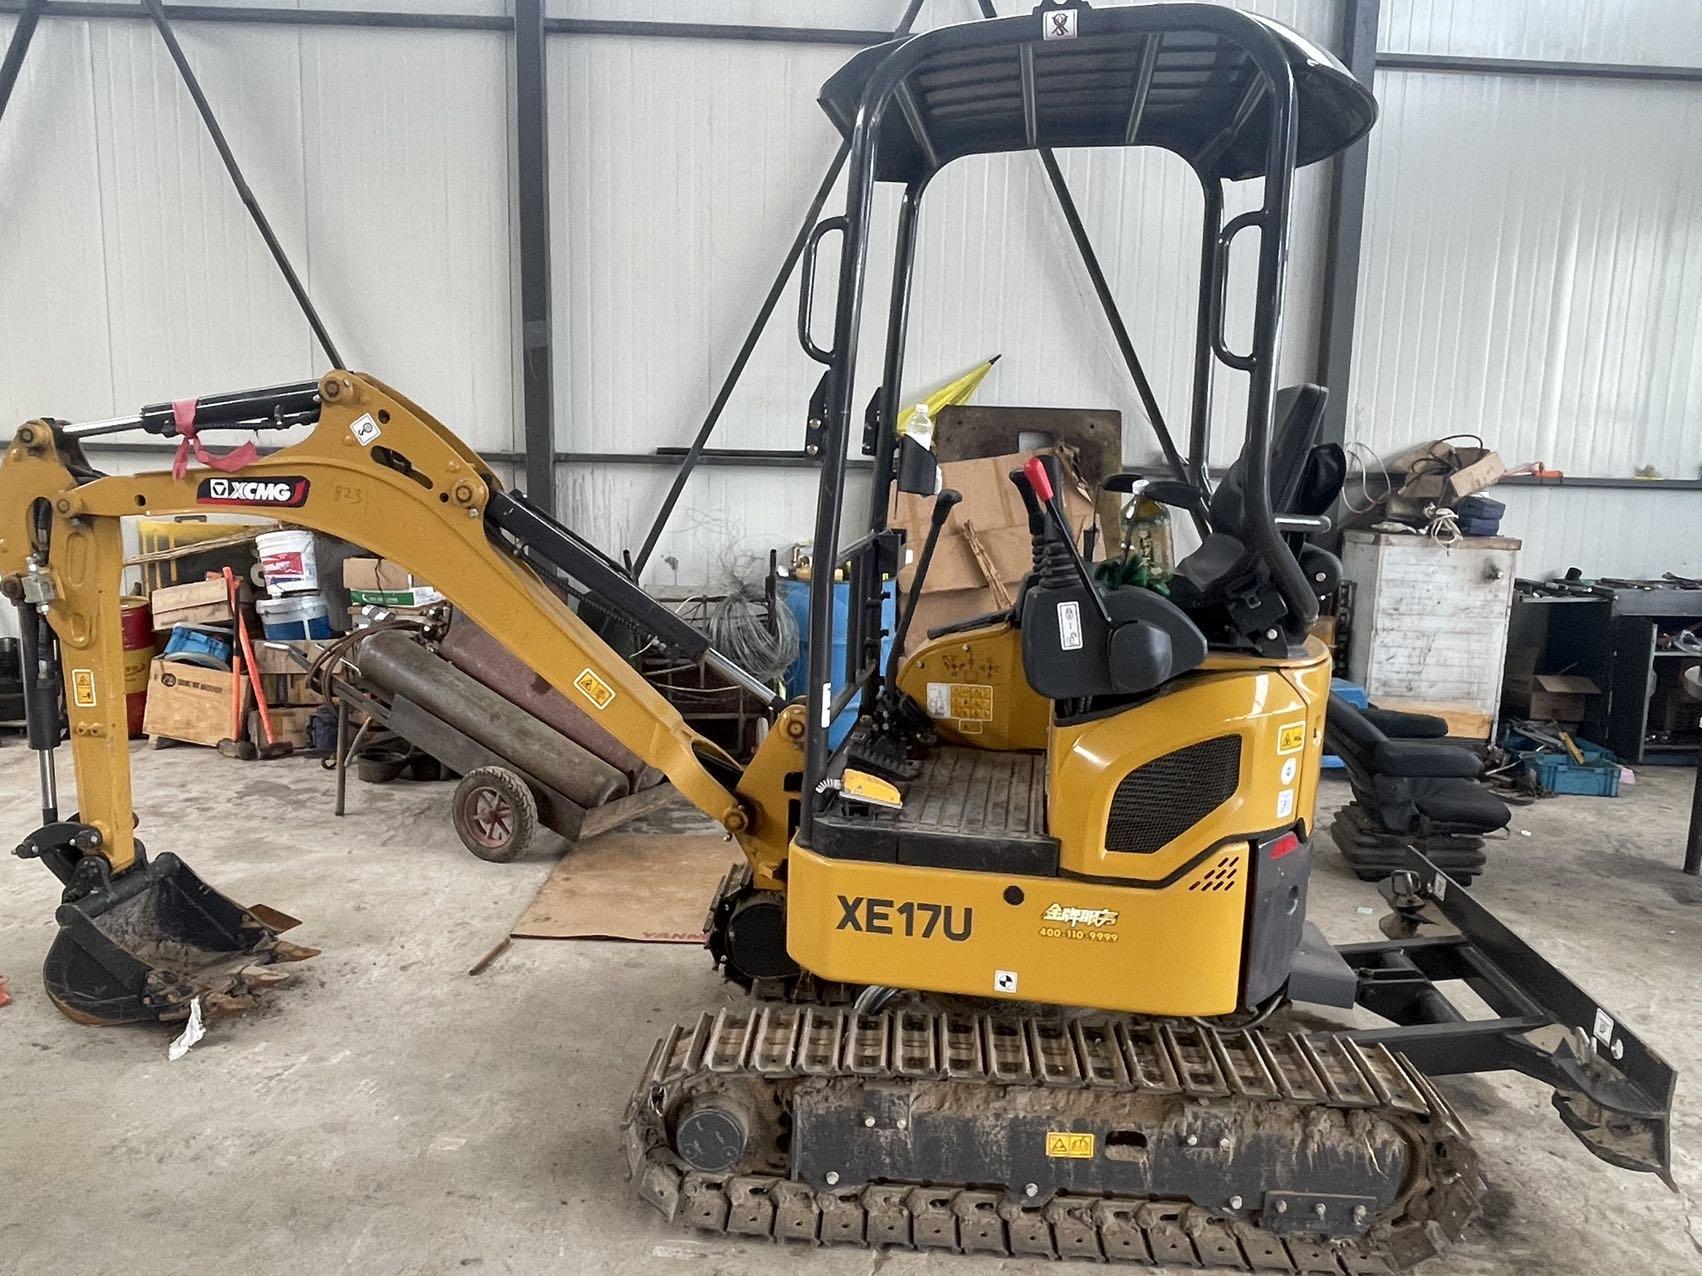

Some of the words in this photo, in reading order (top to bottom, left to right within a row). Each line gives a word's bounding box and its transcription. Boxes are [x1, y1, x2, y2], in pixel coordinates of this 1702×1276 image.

[229, 481, 291, 502] XCMG
[836, 894, 973, 942] XE17U
[1039, 927, 1120, 943] 400-110-9999
